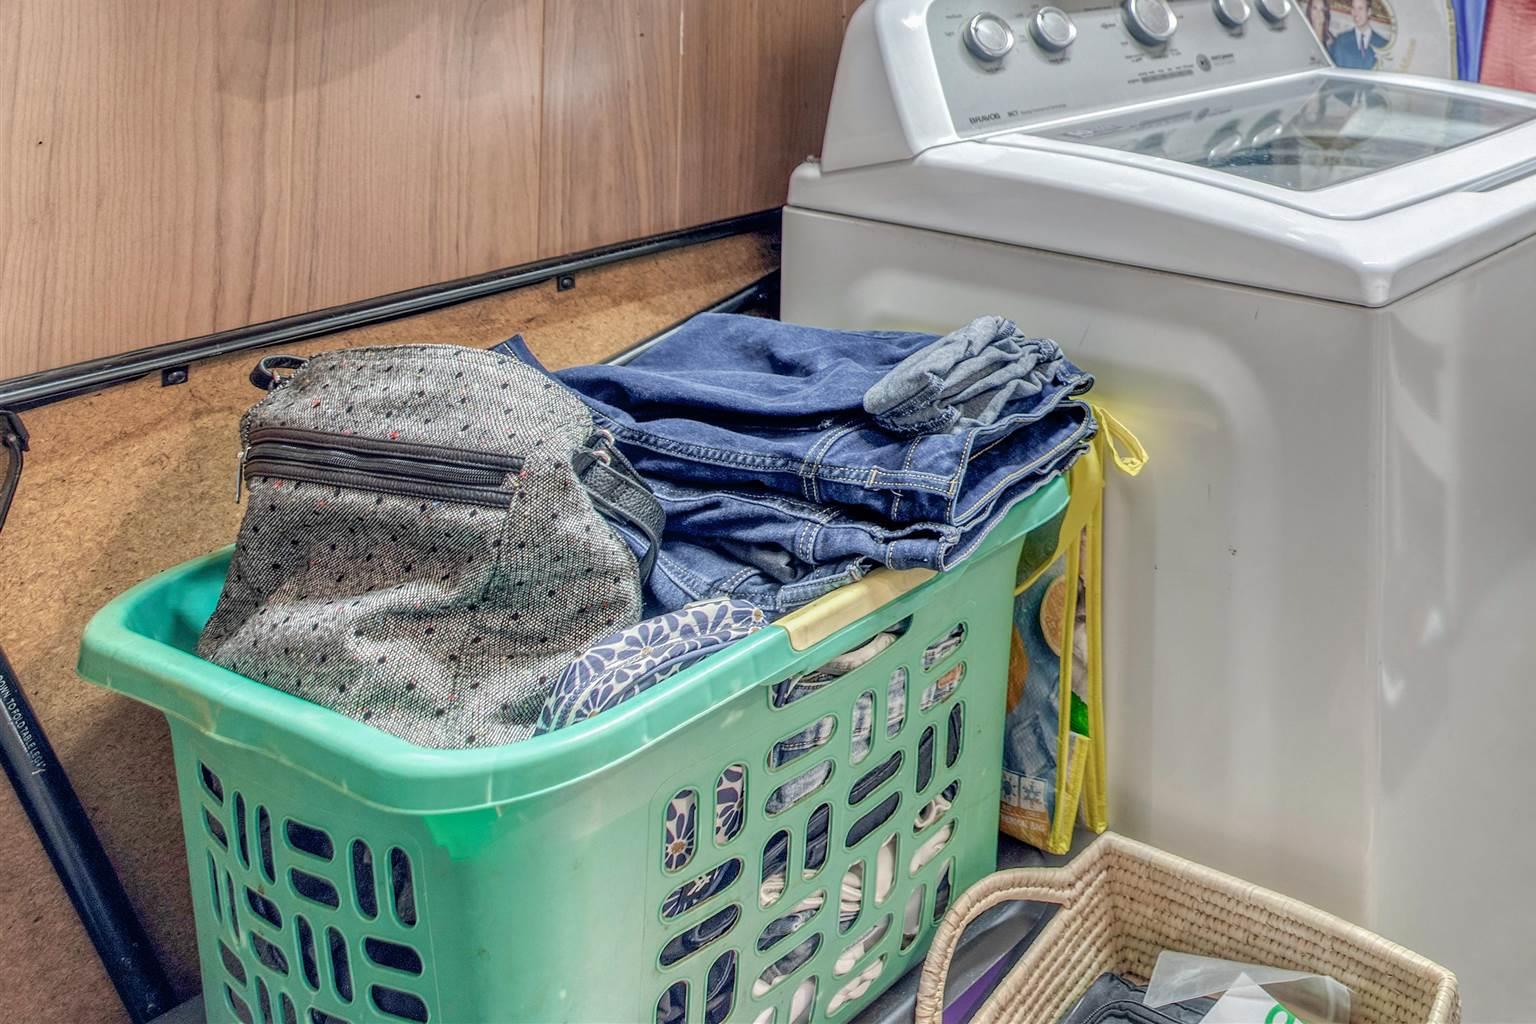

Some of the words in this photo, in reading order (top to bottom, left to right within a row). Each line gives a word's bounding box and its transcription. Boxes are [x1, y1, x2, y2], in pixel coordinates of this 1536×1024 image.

[6, 697, 17, 711] TO
[11, 708, 27, 729] FOLD
[20, 725, 37, 751] TABLE
